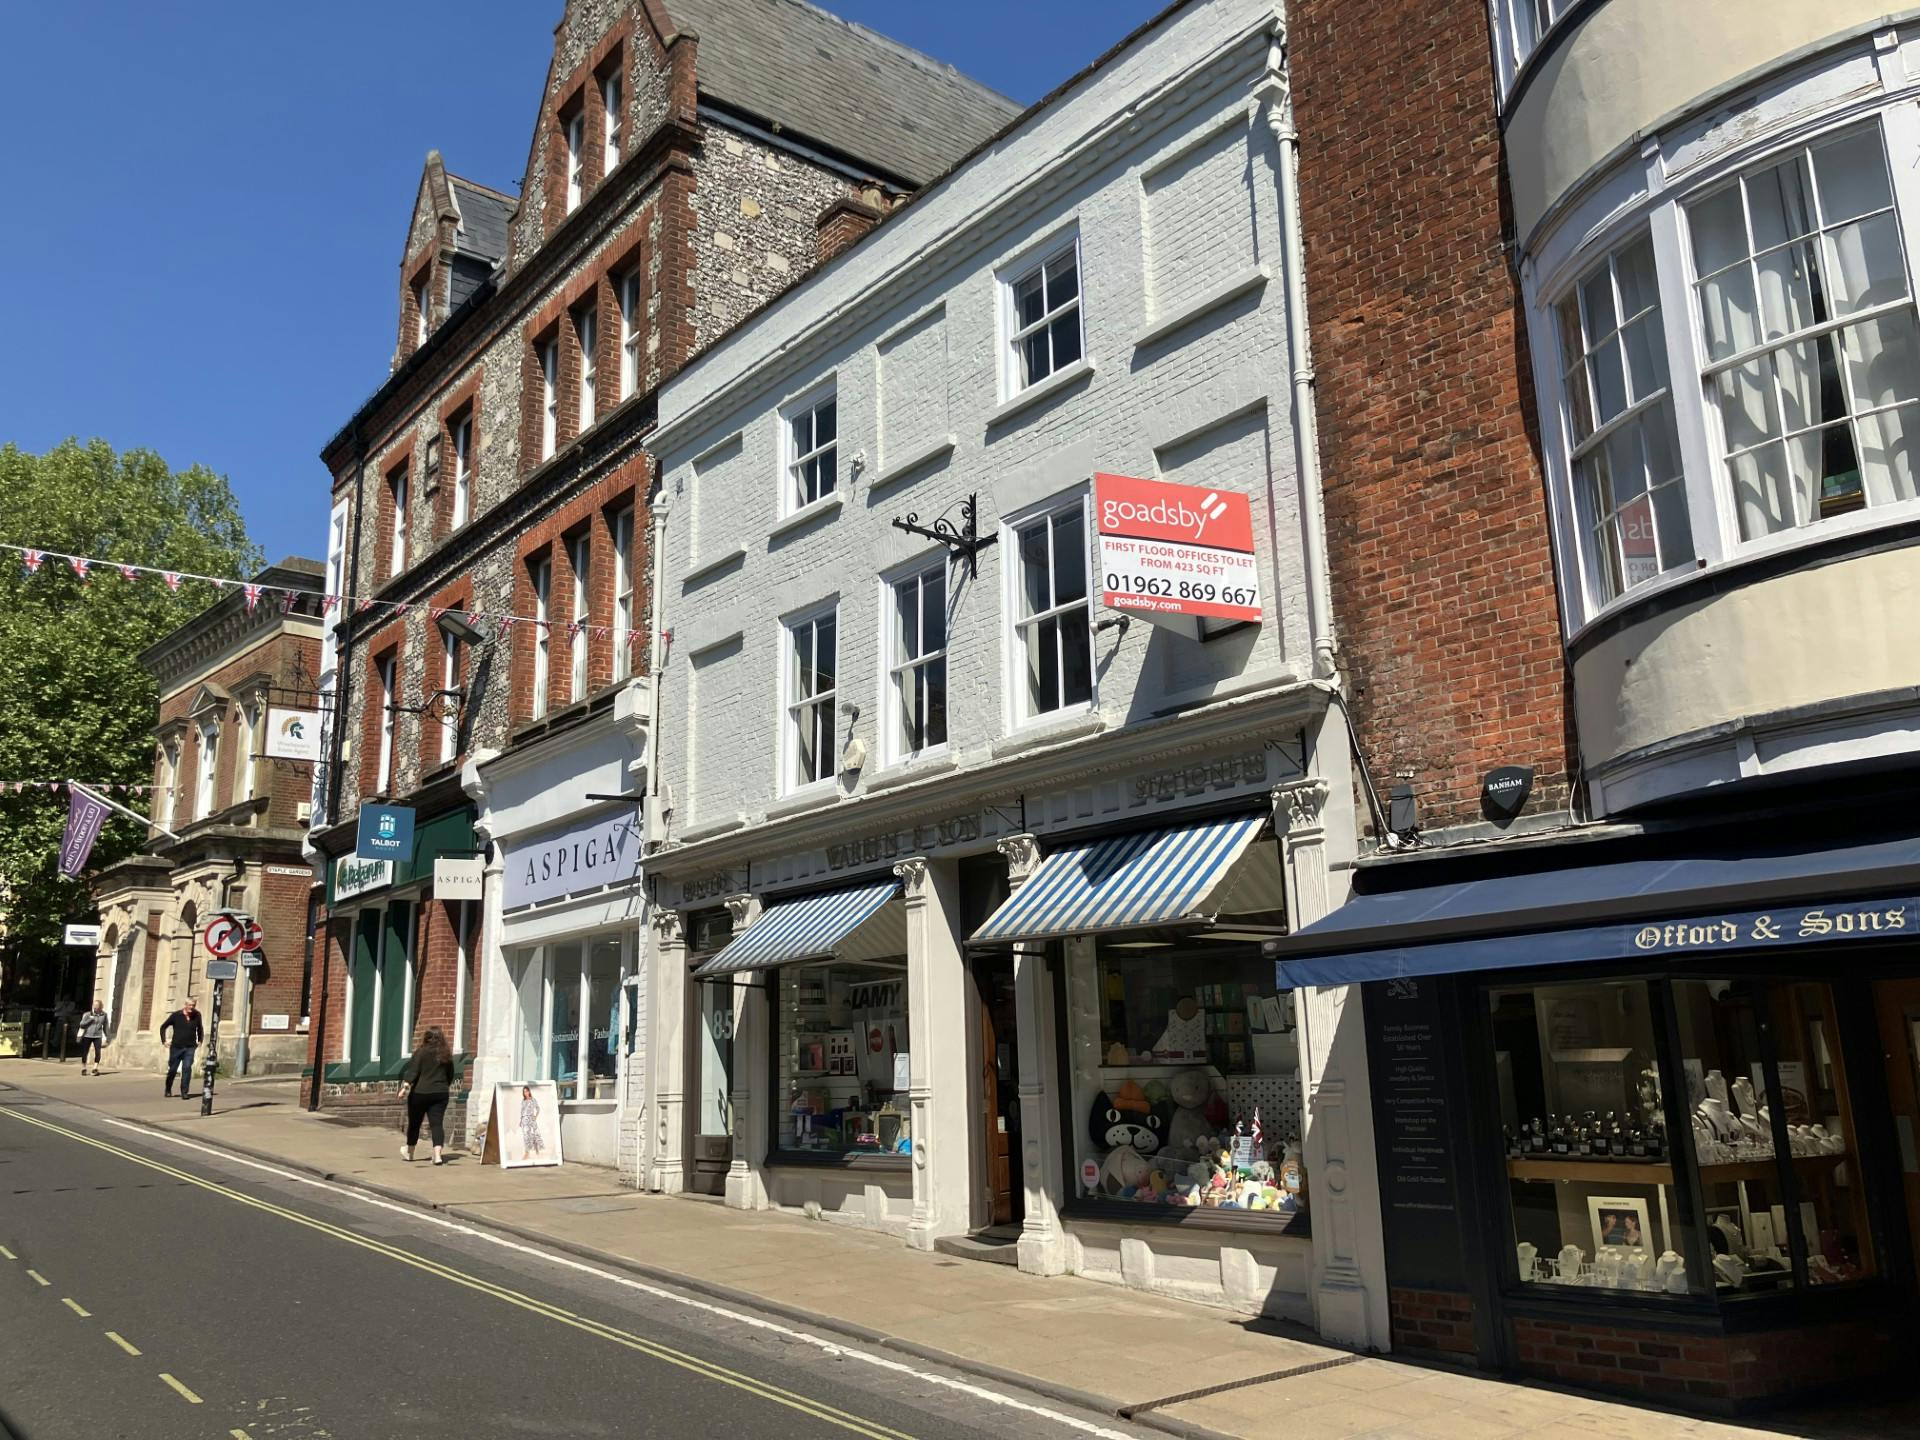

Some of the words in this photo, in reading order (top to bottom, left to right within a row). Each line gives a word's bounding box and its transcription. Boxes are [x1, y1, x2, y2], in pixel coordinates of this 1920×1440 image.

[1103, 499, 1207, 539] goadsby
[1105, 541, 1136, 553] FIRST
[1138, 544, 1174, 558] FLOOR
[1176, 549, 1219, 563] OFFICES
[1222, 555, 1234, 566] TO
[1236, 556, 1254, 568] LET
[1140, 558, 1172, 569] FROM
[1174, 561, 1194, 572] 423
[1196, 564, 1210, 576] SQ
[1213, 566, 1225, 576] FT
[1106, 574, 1173, 597] 01962
[1179, 581, 1216, 600] 869
[1222, 587, 1256, 606] 667
[1114, 596, 1182, 610] goadsby.com
[1488, 779, 1522, 791] BANHAM
[370, 838, 401, 847] TALBOT
[525, 832, 617, 886] ASPIGA
[438, 874, 482, 884] ASPIGA
[1635, 916, 1738, 949] Offord
[1750, 915, 1782, 940] &
[1798, 905, 1906, 938] Sons
[851, 982, 901, 1010] LAMY
[594, 1028, 610, 1040] Fashi
[714, 1010, 732, 1040] 85
